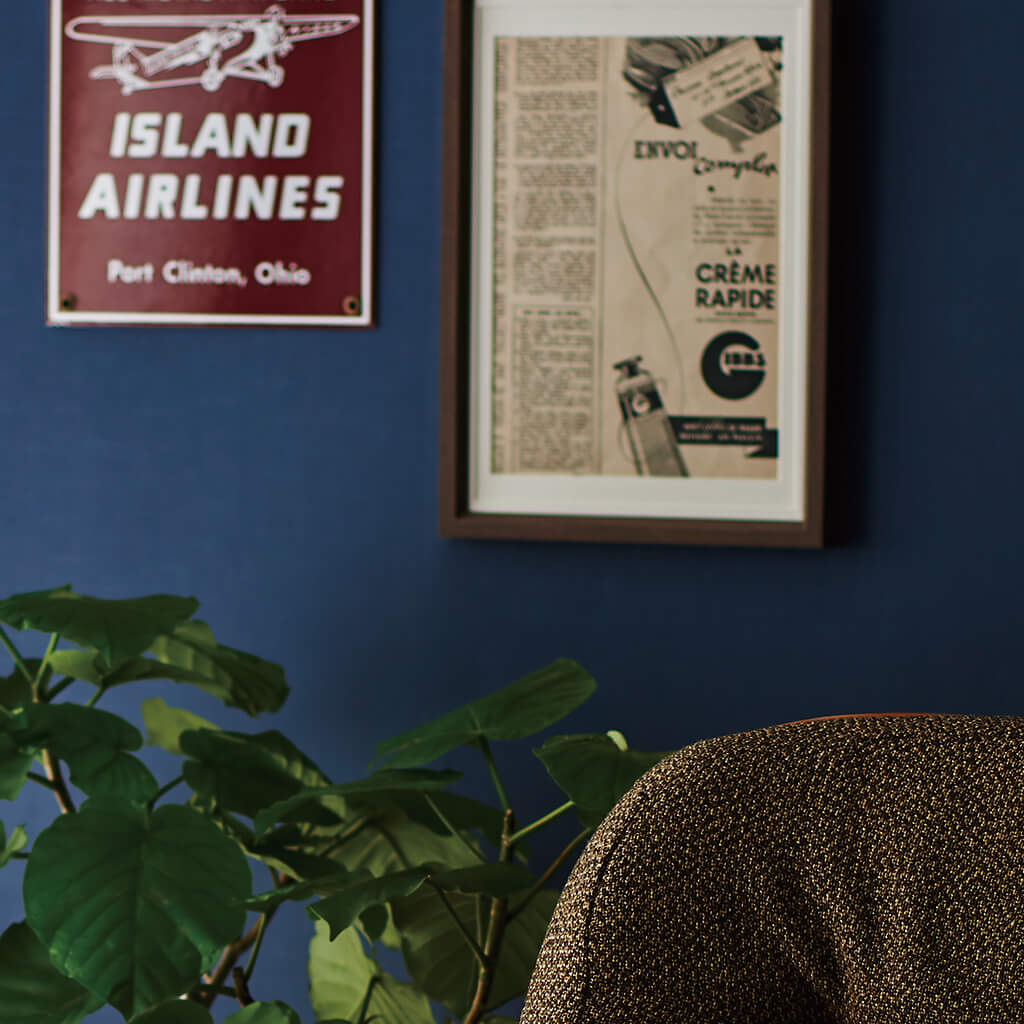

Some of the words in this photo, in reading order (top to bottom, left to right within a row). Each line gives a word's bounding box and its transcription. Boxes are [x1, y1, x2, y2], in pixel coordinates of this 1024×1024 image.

[109, 112, 311, 158] ISLAND
[634, 140, 697, 159] ENVOI
[78, 173, 344, 220] AIRLINES
[107, 259, 153, 283] Port
[162, 260, 247, 287] Clinton,
[254, 261, 311, 285] Ohio
[695, 260, 776, 285] CRÊME
[695, 288, 776, 310] RAPIDE
